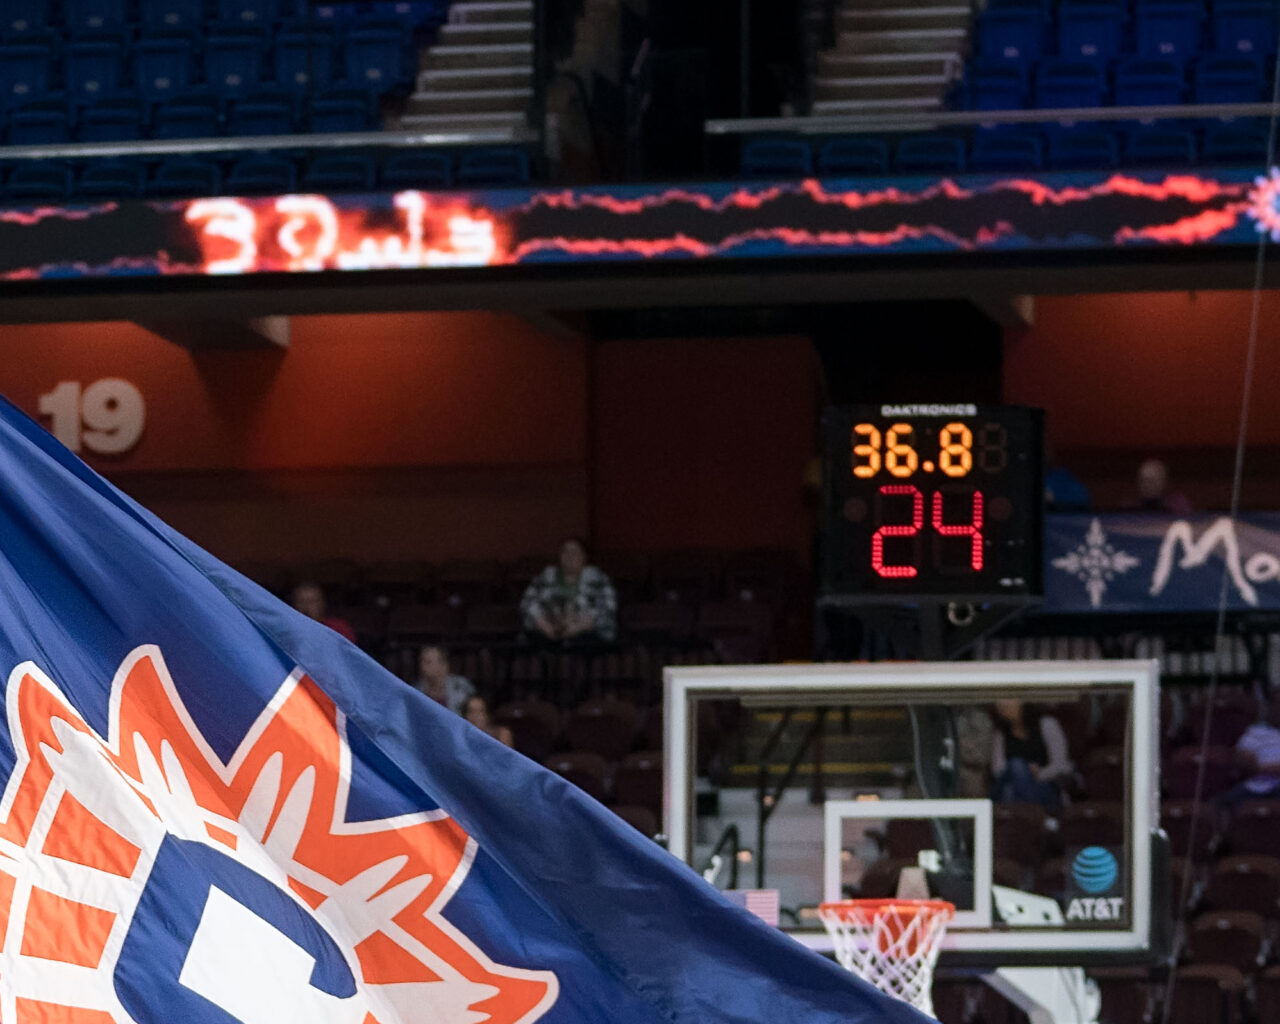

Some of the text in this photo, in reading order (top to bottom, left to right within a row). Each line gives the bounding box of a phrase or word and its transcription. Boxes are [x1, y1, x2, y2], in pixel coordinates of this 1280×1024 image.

[38, 377, 145, 454] 19
[880, 403, 977, 417] DAKTRONICS
[853, 422, 973, 478] 36.8
[872, 484, 983, 579] 24
[1066, 897, 1123, 920] AT&T
